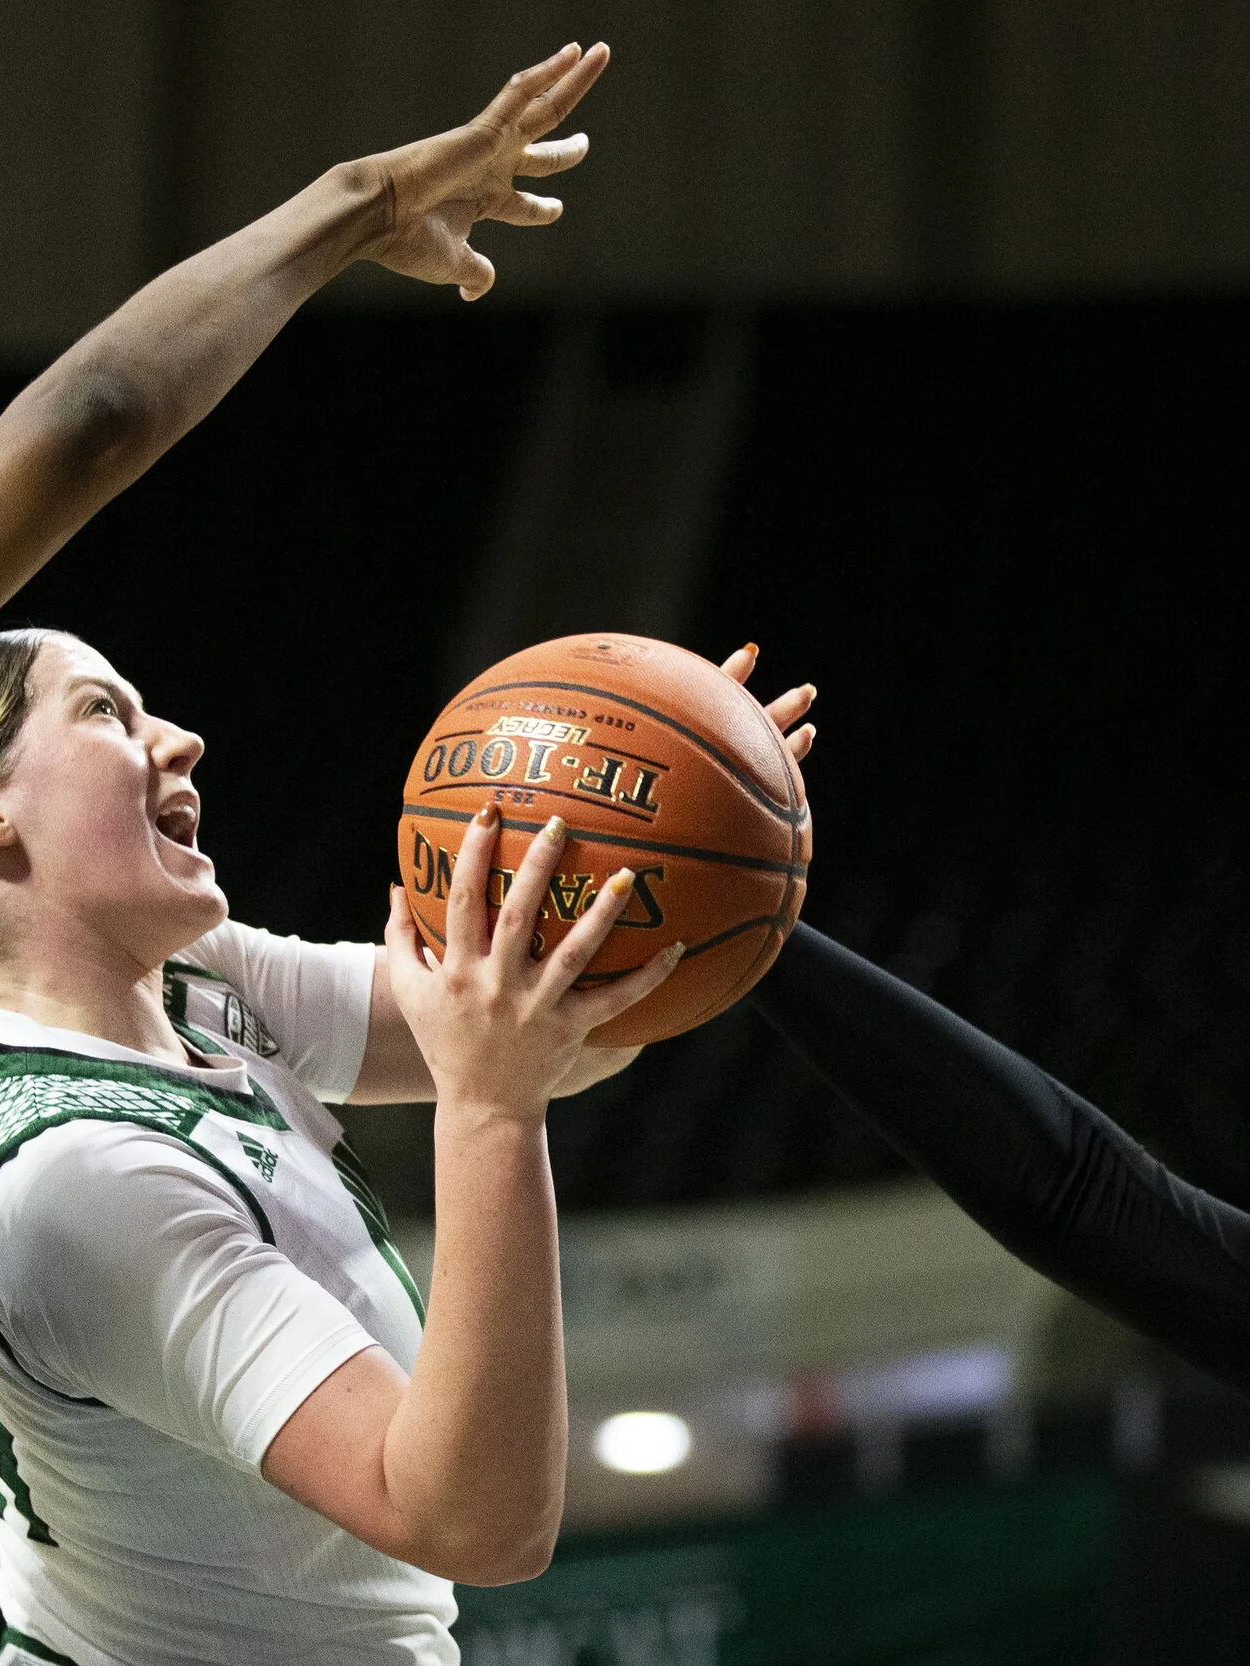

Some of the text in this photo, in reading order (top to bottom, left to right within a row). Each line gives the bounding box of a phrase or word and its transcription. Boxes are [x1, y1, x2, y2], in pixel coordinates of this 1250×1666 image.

[488, 717, 589, 745] LEGACY
[594, 714, 636, 731] DEEP
[423, 737, 661, 816] TF-1000
[494, 790, 534, 807] 28.5
